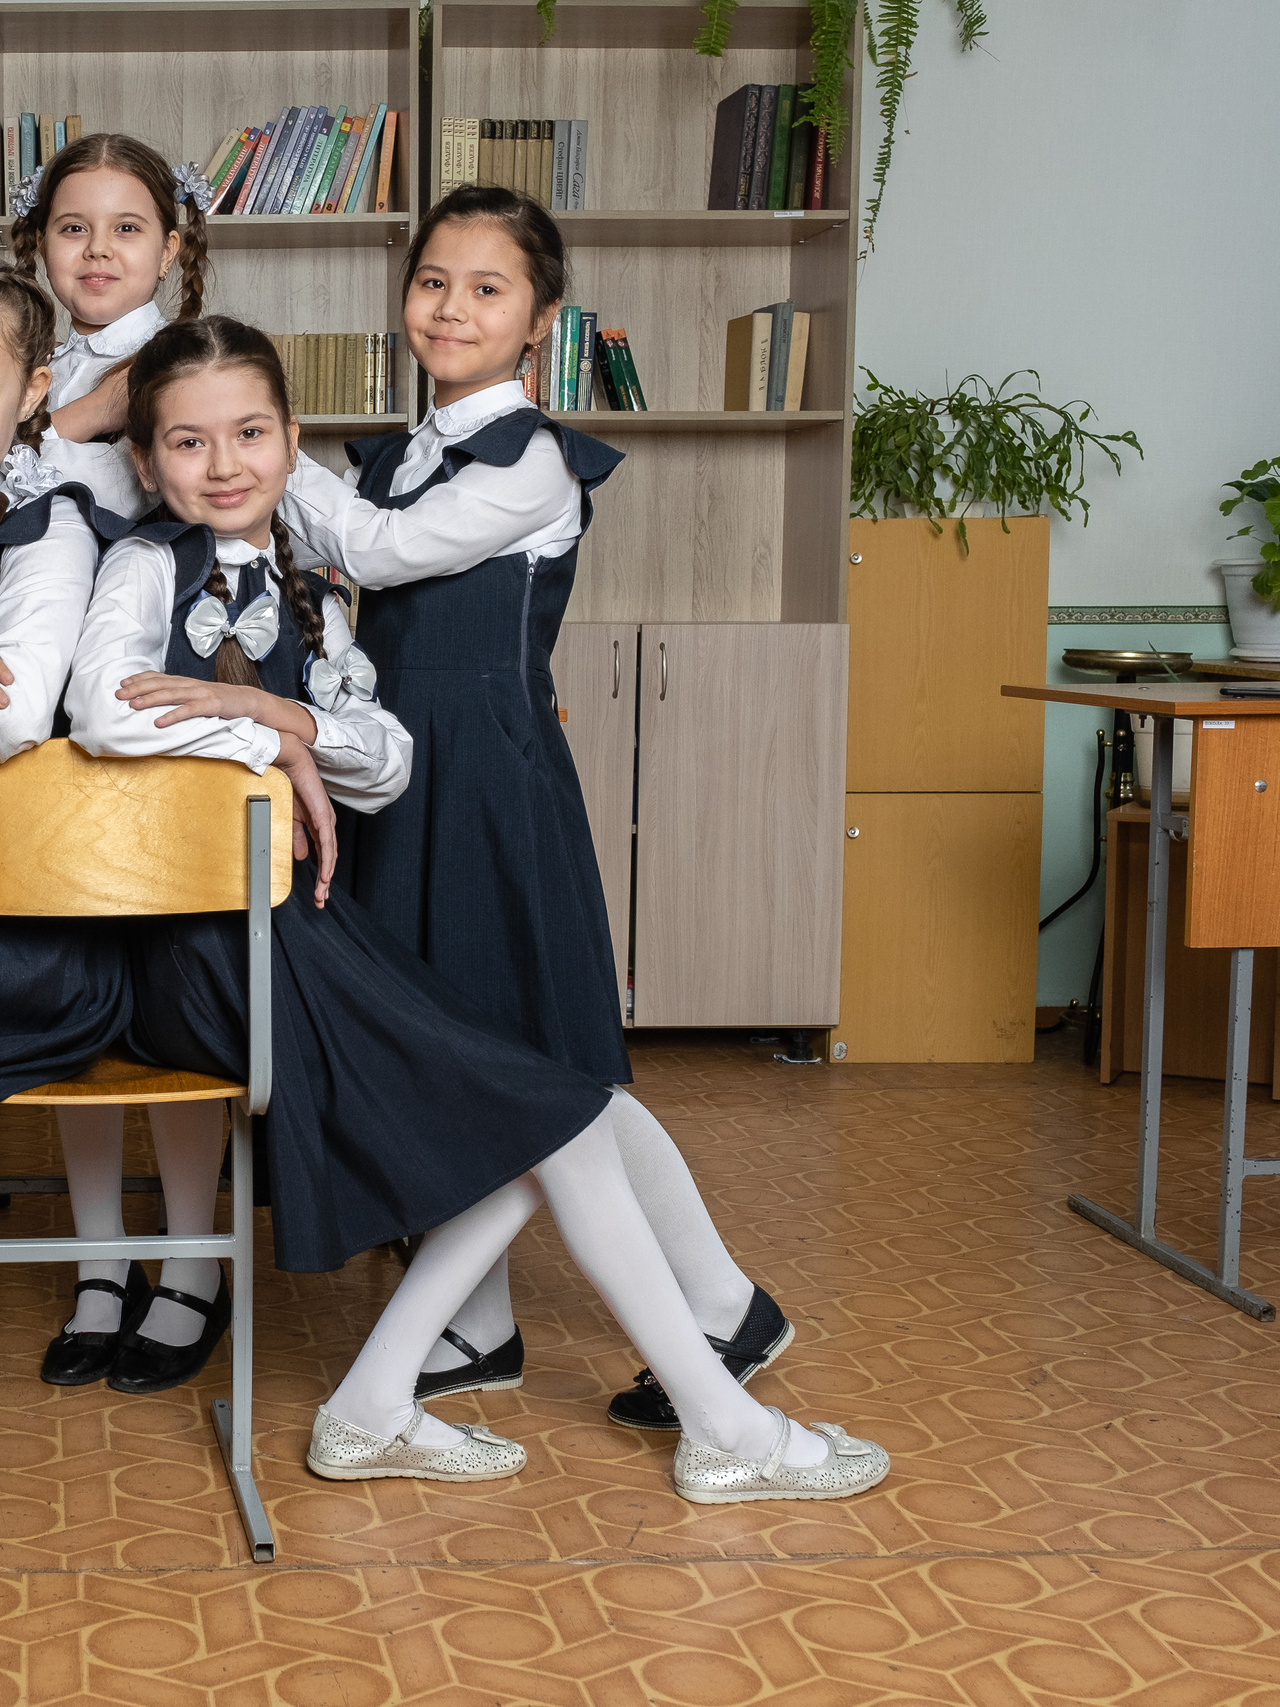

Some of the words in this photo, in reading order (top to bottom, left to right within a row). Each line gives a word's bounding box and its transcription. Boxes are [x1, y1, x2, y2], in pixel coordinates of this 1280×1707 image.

[222, 145, 248, 189] ЛИТЕРАТУРА
[245, 141, 266, 186] ЛИТЕРАТУРА
[303, 139, 324, 184] ЛИТЕРАТУРА
[335, 137, 356, 185] ЛИТЕРАТУРА
[556, 141, 565, 170] Стефан
[555, 171, 564, 200] ЦВЕЙГ
[571, 172, 584, 199] Сага
[325, 203, 333, 212] 8
[377, 201, 386, 211] 9
[759, 347, 767, 373] БЛОК
